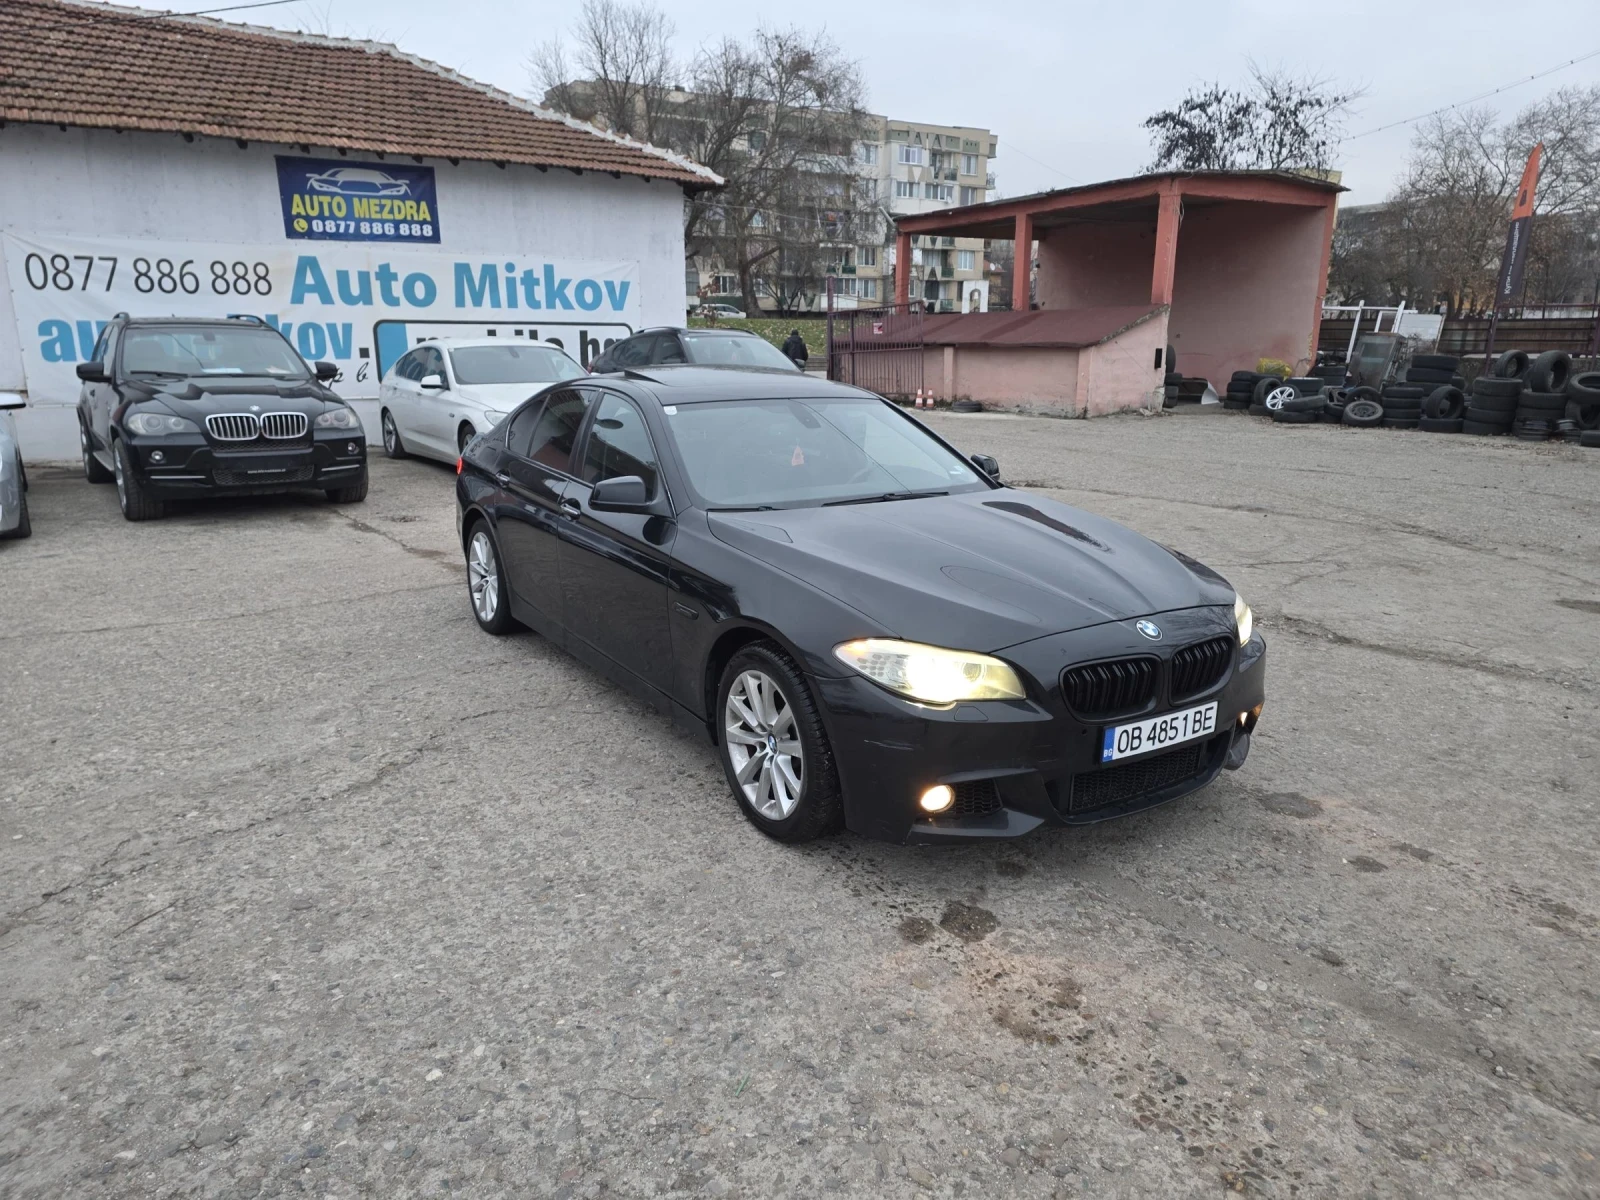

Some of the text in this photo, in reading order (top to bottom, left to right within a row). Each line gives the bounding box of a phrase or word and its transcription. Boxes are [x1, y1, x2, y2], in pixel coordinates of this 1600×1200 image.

[291, 193, 432, 221] AUTO MEZDRA
[311, 219, 433, 237] 0877 886 888
[24, 252, 273, 296] 0877 886 888
[289, 255, 631, 312] Auto Mitkov
[1117, 706, 1214, 754] OB 4851 BE
[1103, 748, 1113, 758] BG
